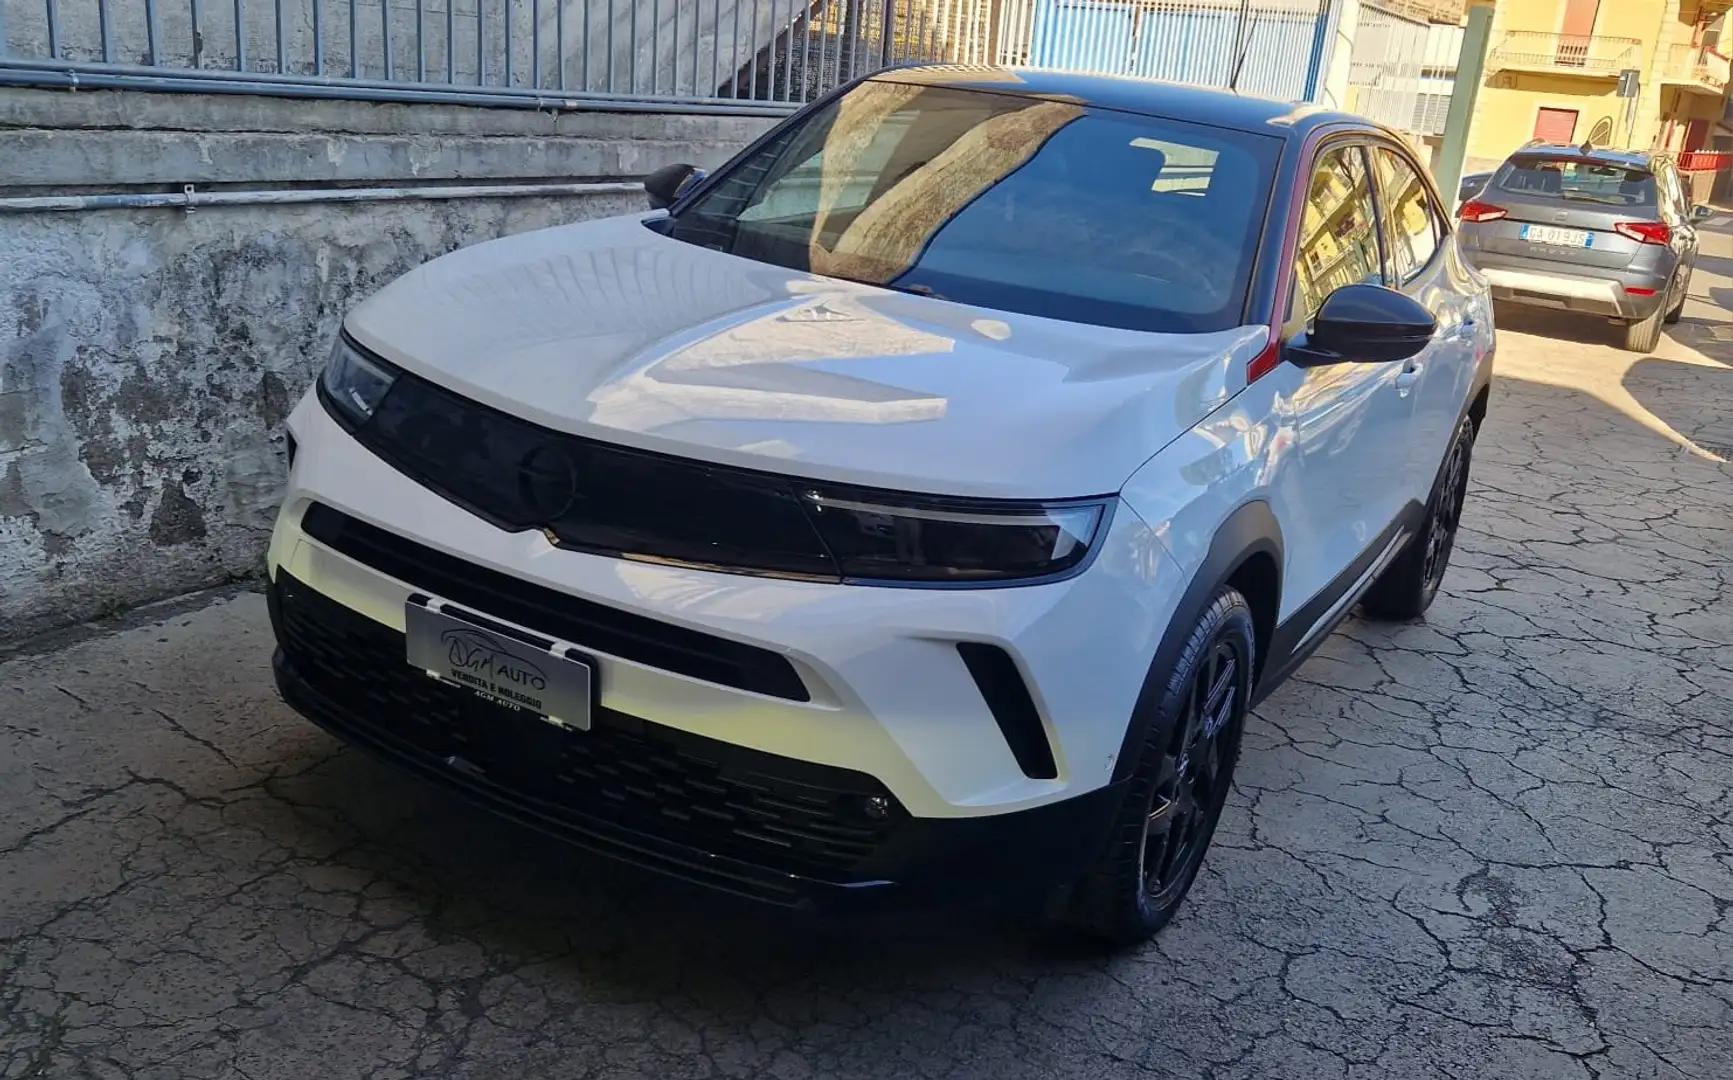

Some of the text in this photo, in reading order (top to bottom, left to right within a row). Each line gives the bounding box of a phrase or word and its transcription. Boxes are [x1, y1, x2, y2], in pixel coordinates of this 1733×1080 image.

[450, 668, 542, 709] VENDITA E NOLEGGIO
[497, 665, 546, 691] AUTO
[474, 690, 521, 711] AGM AUTO
